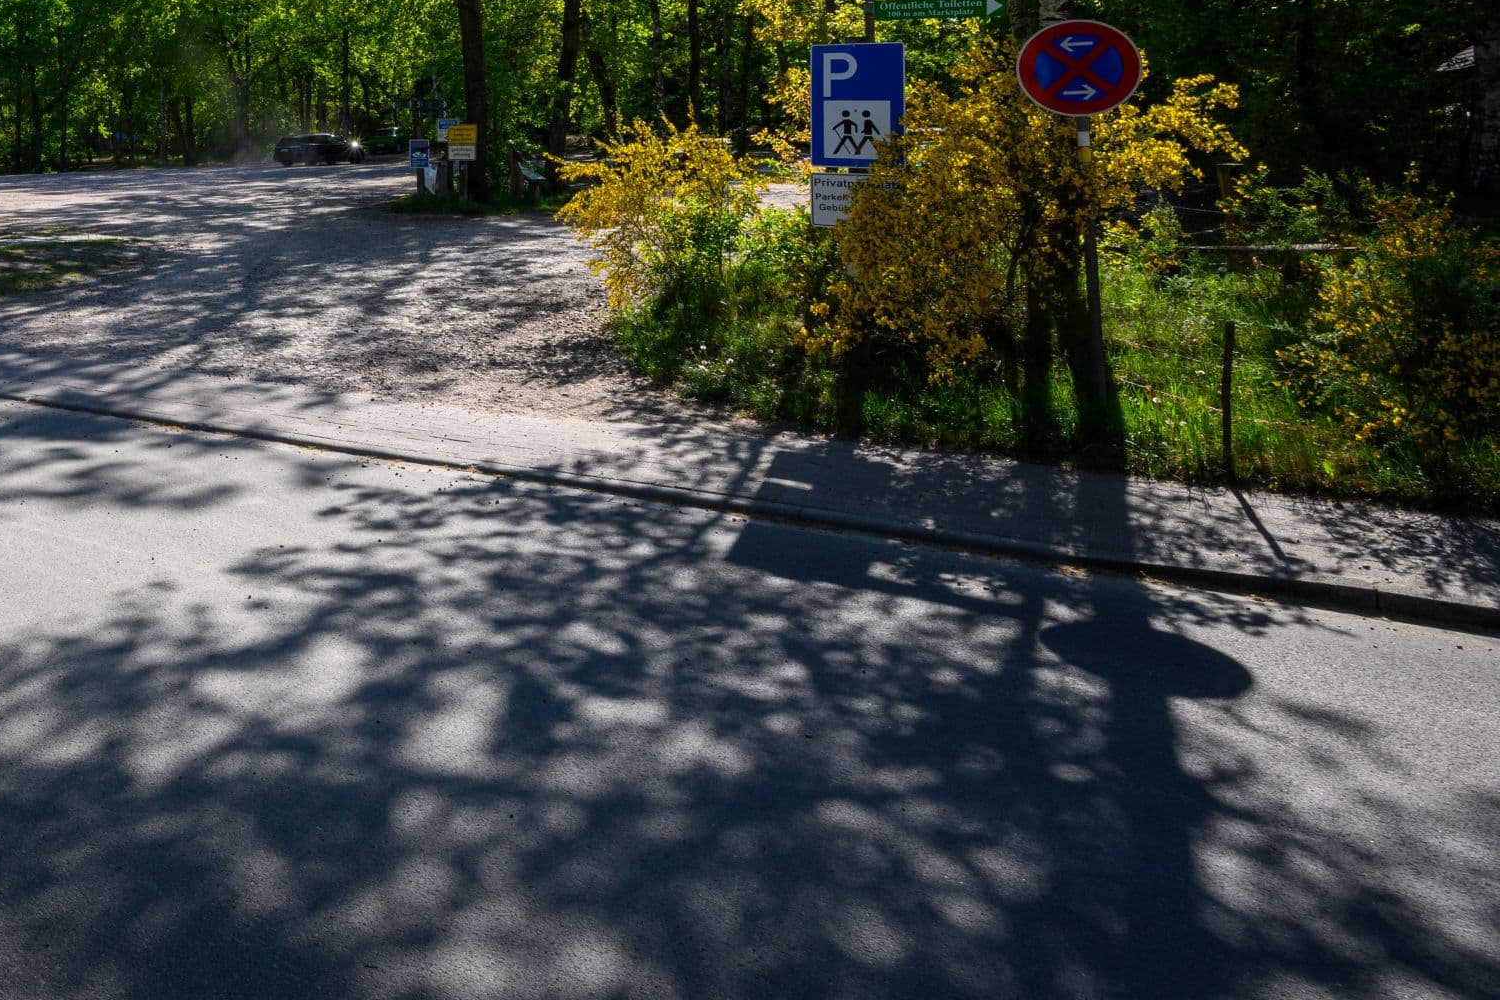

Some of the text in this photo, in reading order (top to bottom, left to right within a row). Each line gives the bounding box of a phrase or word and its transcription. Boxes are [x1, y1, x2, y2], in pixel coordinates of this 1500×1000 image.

[937, 0, 983, 8] Toiletten
[928, 8, 975, 17] Marktplatz
[823, 52, 857, 97] P
